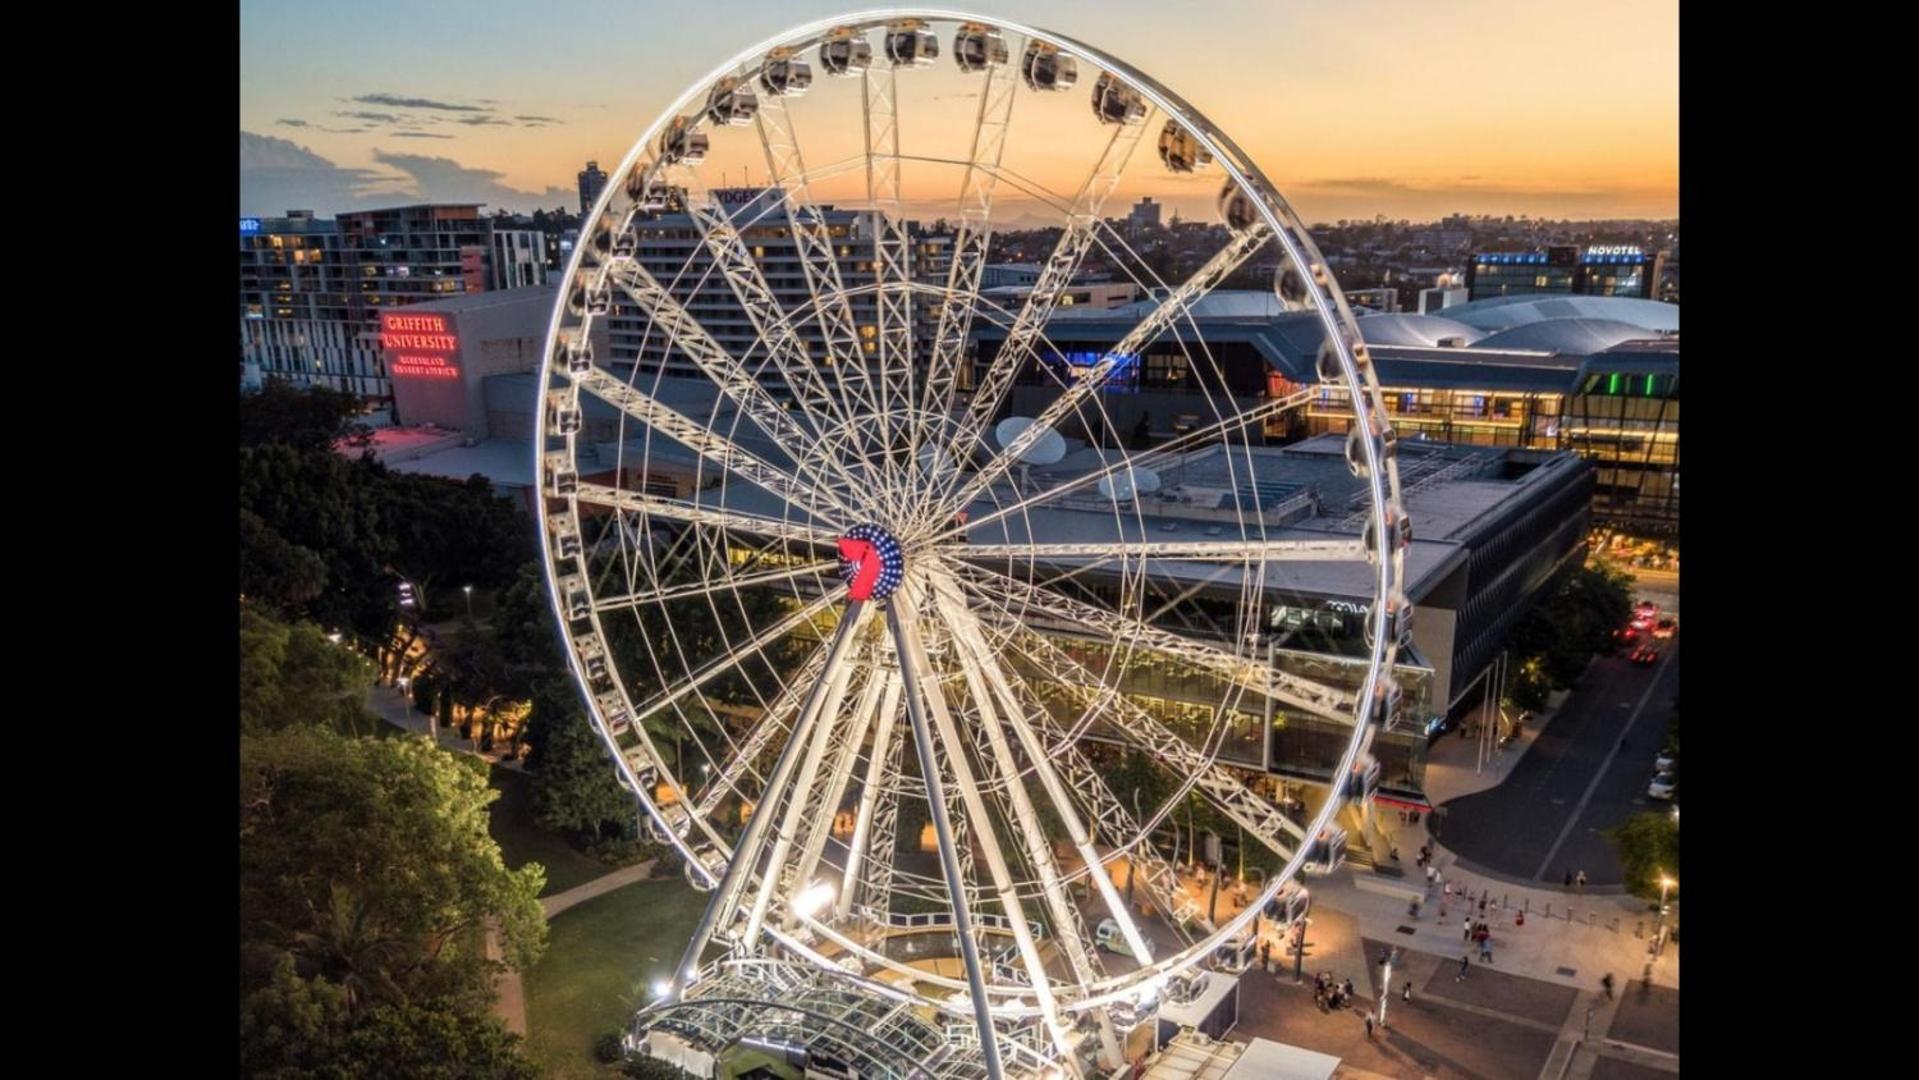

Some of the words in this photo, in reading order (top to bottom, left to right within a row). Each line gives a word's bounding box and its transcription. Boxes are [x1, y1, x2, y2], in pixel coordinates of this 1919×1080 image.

[713, 190, 757, 204] YDGES
[1588, 245, 1641, 256] NOVOTEL
[388, 316, 444, 332] GRIFFITH
[384, 334, 455, 350] UNIVERSITY
